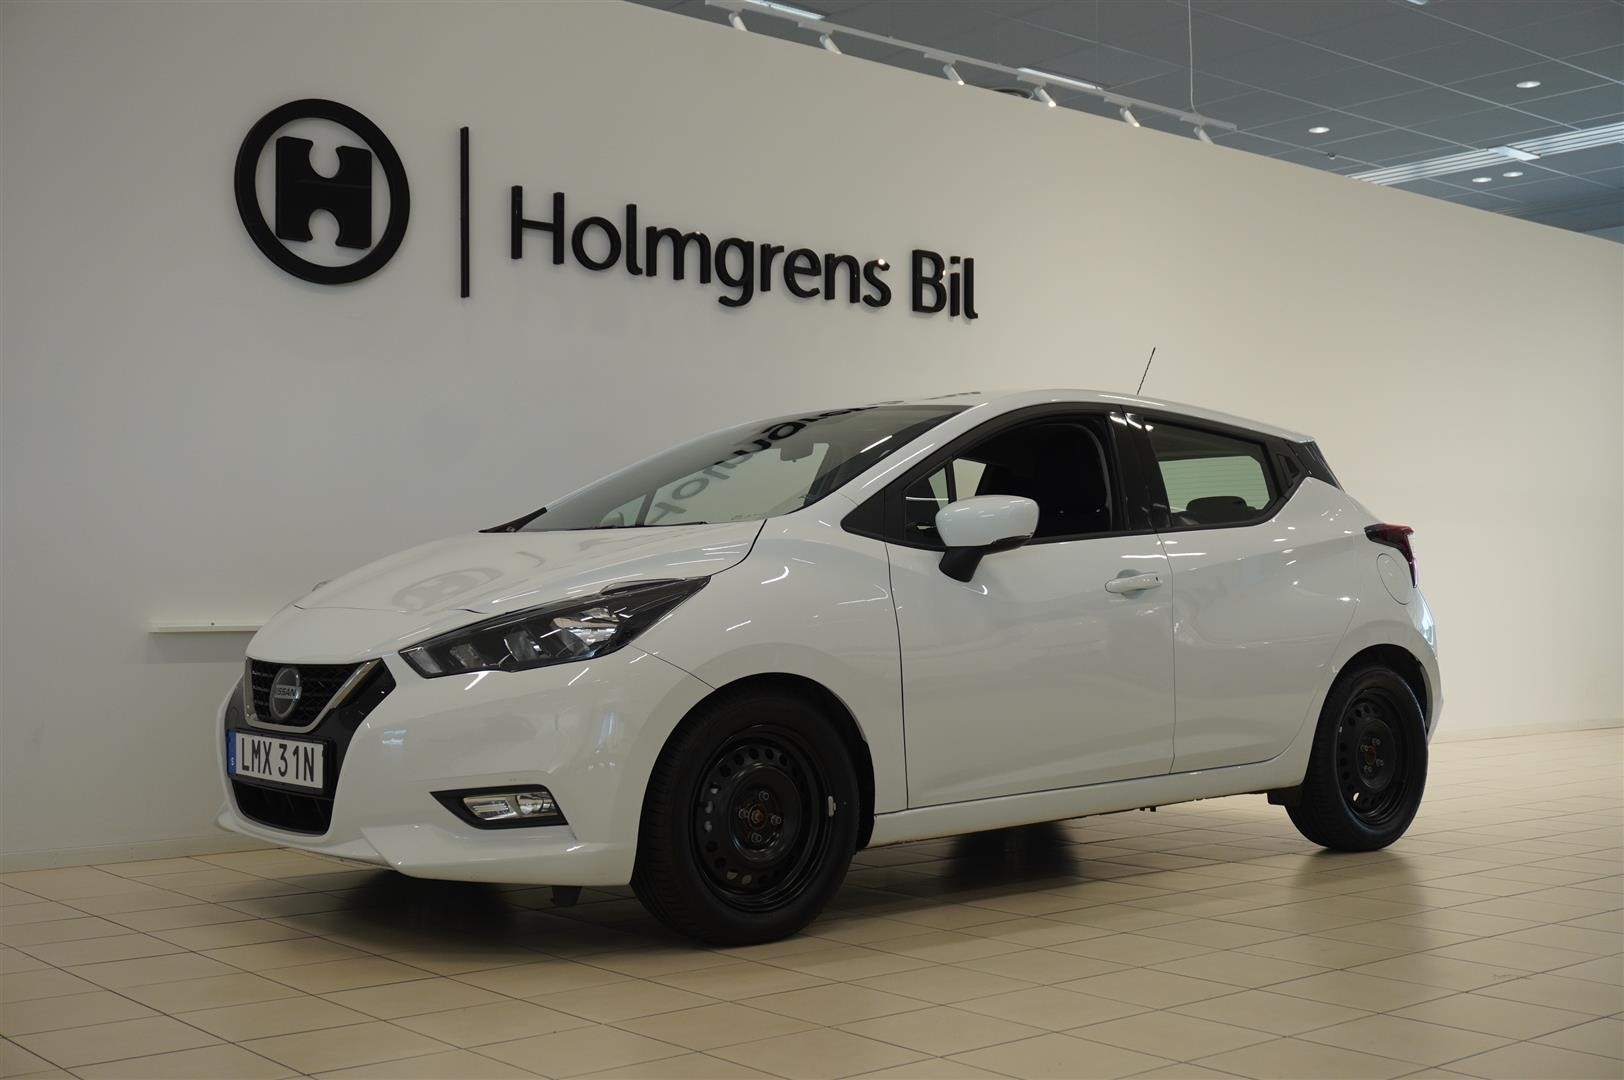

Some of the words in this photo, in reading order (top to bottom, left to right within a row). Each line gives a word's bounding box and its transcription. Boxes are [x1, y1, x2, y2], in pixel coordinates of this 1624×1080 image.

[511, 185, 892, 307] Holmgrens
[911, 249, 979, 319] Bil
[272, 686, 298, 697] SSAN
[241, 738, 272, 775] LMX
[278, 743, 315, 782] 31N
